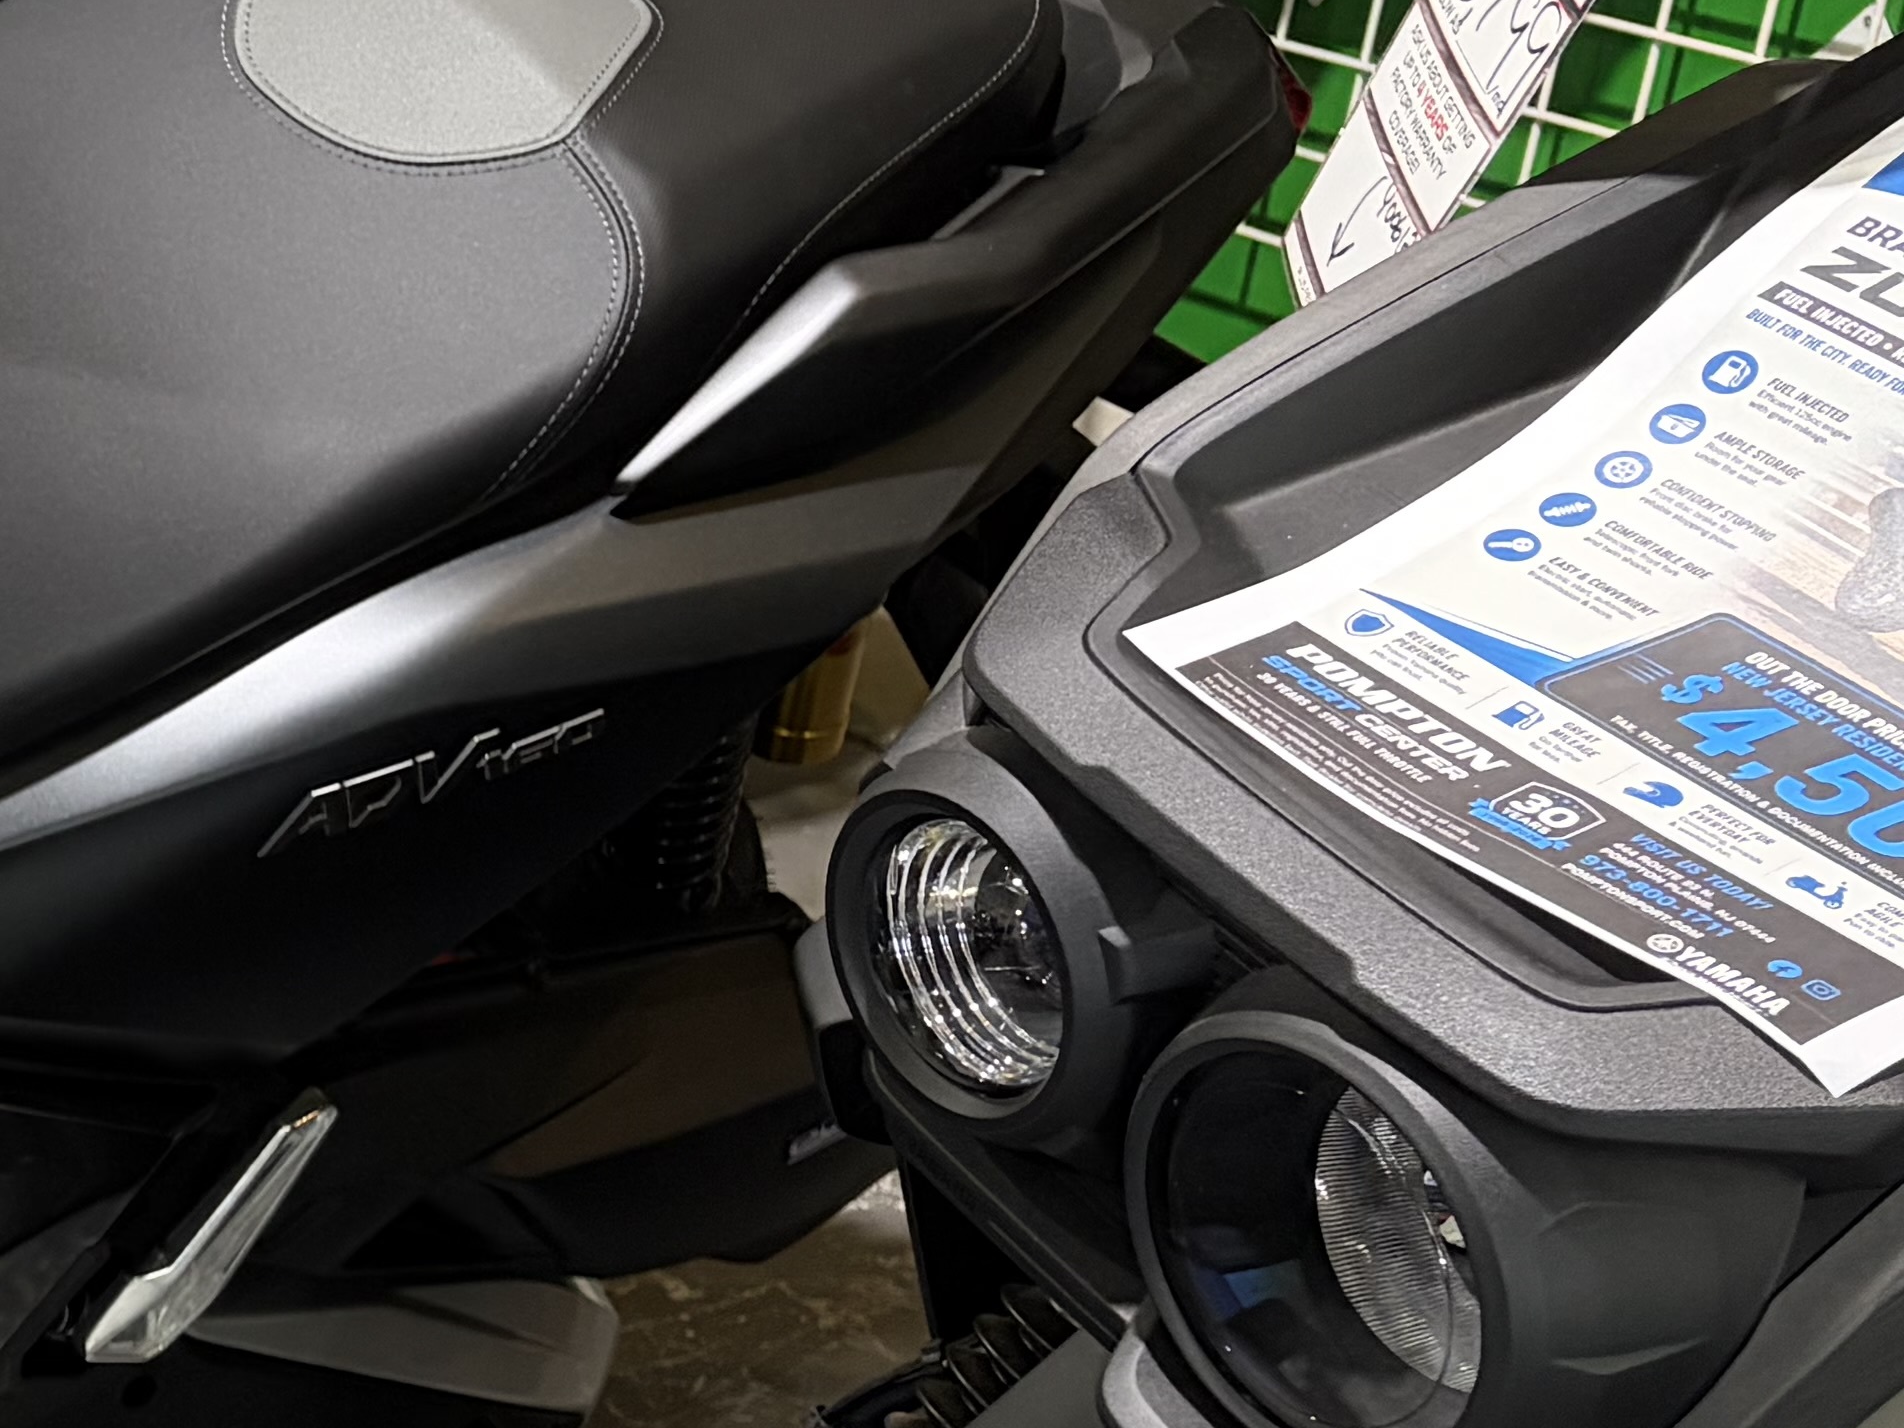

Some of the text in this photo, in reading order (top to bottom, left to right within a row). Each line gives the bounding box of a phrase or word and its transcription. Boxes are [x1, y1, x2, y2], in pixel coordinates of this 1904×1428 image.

[1391, 66, 1447, 179] FACTORY WARRANTY
[1421, 95, 1449, 141] YEARS
[1427, 61, 1447, 99] ABOUT
[1444, 97, 1477, 149] GETTING
[1746, 308, 1782, 329] BUILT
[1776, 323, 1803, 341] FOR
[1798, 334, 1825, 353] THE
[1848, 358, 1889, 383] READY
[1773, 289, 1884, 348] FUEL INJECTED
[1767, 378, 1850, 423] FUEL INJECTED
[1714, 432, 1806, 480] AMPLE STORAGE
[1660, 478, 1777, 542] CONFIDENT STOPPING
[1604, 520, 1685, 565] COMFORTABLE
[1681, 557, 1714, 580] RIDE
[1549, 557, 1582, 575] EASY
[1588, 578, 1661, 617] CONVENIENT
[1392, 637, 1471, 681] PERFORMANCE
[1405, 631, 1459, 661] RELIABLE
[1286, 643, 1511, 772] POMPTON
[1721, 661, 1773, 689] NEW
[1764, 688, 1841, 727] JERSEY
[1744, 652, 1791, 677] OUT
[1783, 672, 1823, 695] THE
[1814, 689, 1871, 723] DOOR
[1256, 672, 1277, 685] 30
[1274, 682, 1311, 706] YEARS
[1316, 708, 1352, 732] STILL
[1346, 728, 1380, 750] FULL
[1373, 747, 1432, 784] THROTTLE
[1262, 655, 1365, 712] SPORT
[1354, 713, 1470, 781] CENTER
[1548, 729, 1601, 758] MILEAGE
[1562, 722, 1602, 744] GREAT
[1501, 806, 1553, 835] YEARS
[1508, 794, 1580, 828] 30
[1671, 750, 1764, 804] REGISTRATION
[1767, 805, 1870, 867] DOCUMENTATION
[1688, 811, 1751, 844] EVERYDAY
[1701, 804, 1751, 832] PERFECT
[1752, 828, 1776, 845] FOR
[1579, 855, 1733, 938] 973-800-1711
[1599, 847, 1670, 886] POMPTON
[1631, 833, 1683, 861] VISIT
[1676, 859, 1707, 875] US
[1704, 873, 1774, 910] TODAY!
[1636, 855, 1688, 882] ROUTE
[1561, 862, 1706, 940] POMPTONSPORT.COM
[1673, 945, 1789, 1016] YAMAHA
